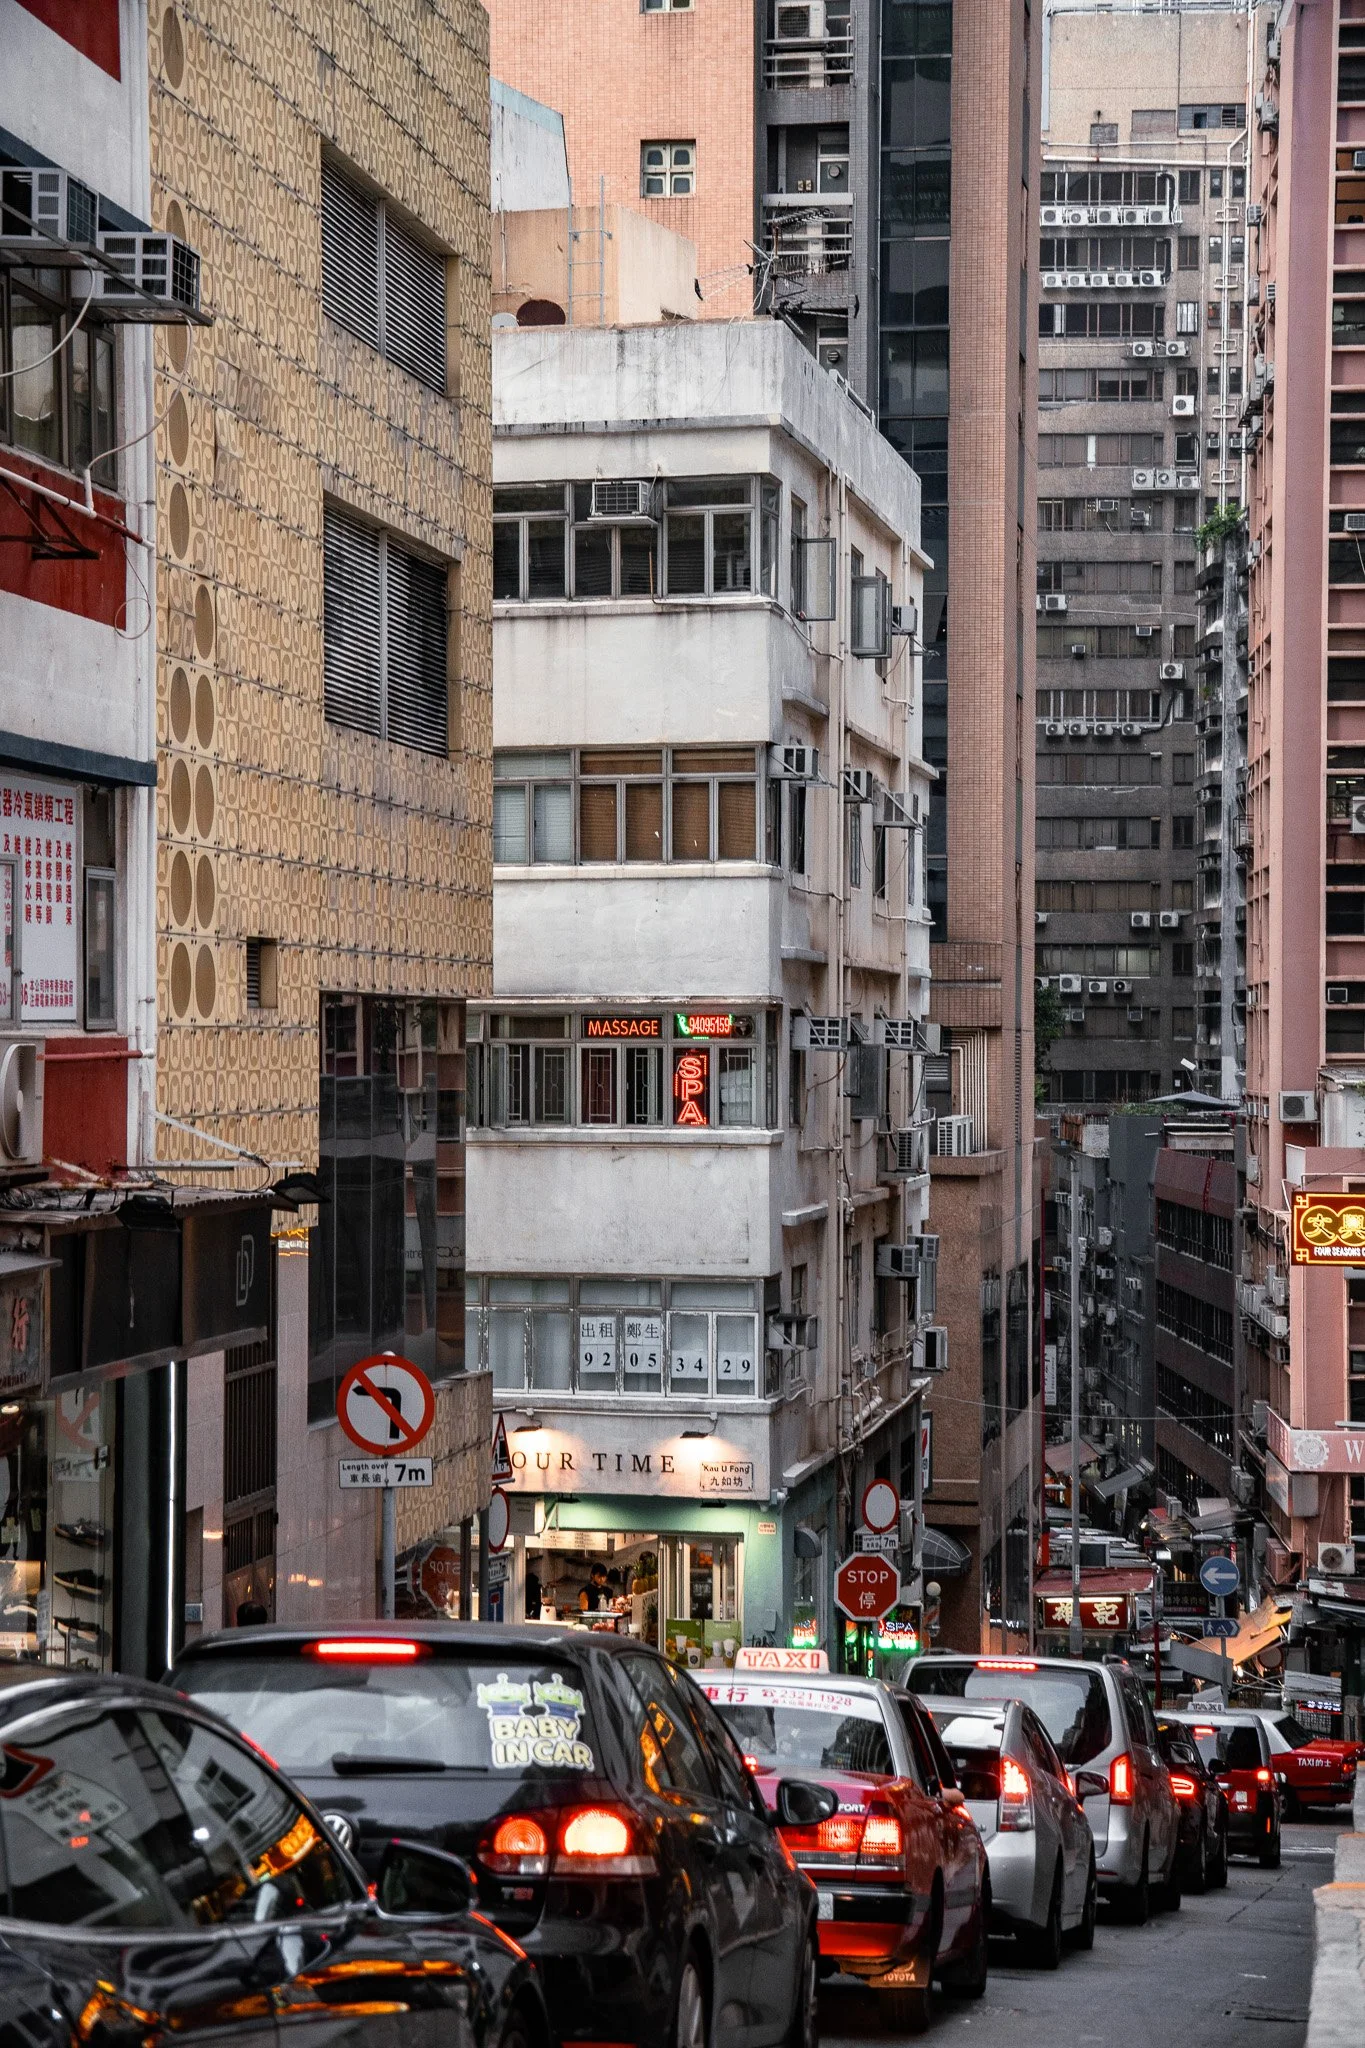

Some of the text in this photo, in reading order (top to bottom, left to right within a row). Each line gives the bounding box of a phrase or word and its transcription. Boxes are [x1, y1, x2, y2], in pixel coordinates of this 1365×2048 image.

[0, 788, 74, 825] 器冷氣鎖類工程
[588, 1019, 659, 1036] MASSAGE
[689, 1016, 730, 1034] 94095159
[677, 1056, 705, 1123] SPA
[1314, 1247, 1331, 1256] FOUR
[1332, 1247, 1361, 1256] SEASONS
[581, 1322, 660, 1339] 出租 鄭生
[592, 1453, 675, 1473] TIME
[721, 1465, 728, 1473] U
[729, 1465, 750, 1474] Fong
[342, 1463, 369, 1472] Length
[394, 1463, 425, 1482] 7m
[350, 1473, 382, 1483] 車長逾
[710, 1476, 743, 1487] 九如坊
[884, 1537, 896, 1547] 7m
[847, 1570, 889, 1584] STOP
[859, 1591, 876, 1609] 停
[885, 1621, 915, 1632] SPA
[743, 1651, 820, 1668] TAXI
[780, 1689, 813, 1700] 2321
[820, 1691, 852, 1706] 1928
[1192, 1702, 1222, 1712] TAXI
[493, 1716, 578, 1740] BABY
[495, 1740, 592, 1768] IN CAR
[883, 1972, 916, 1982] TOYOTA
